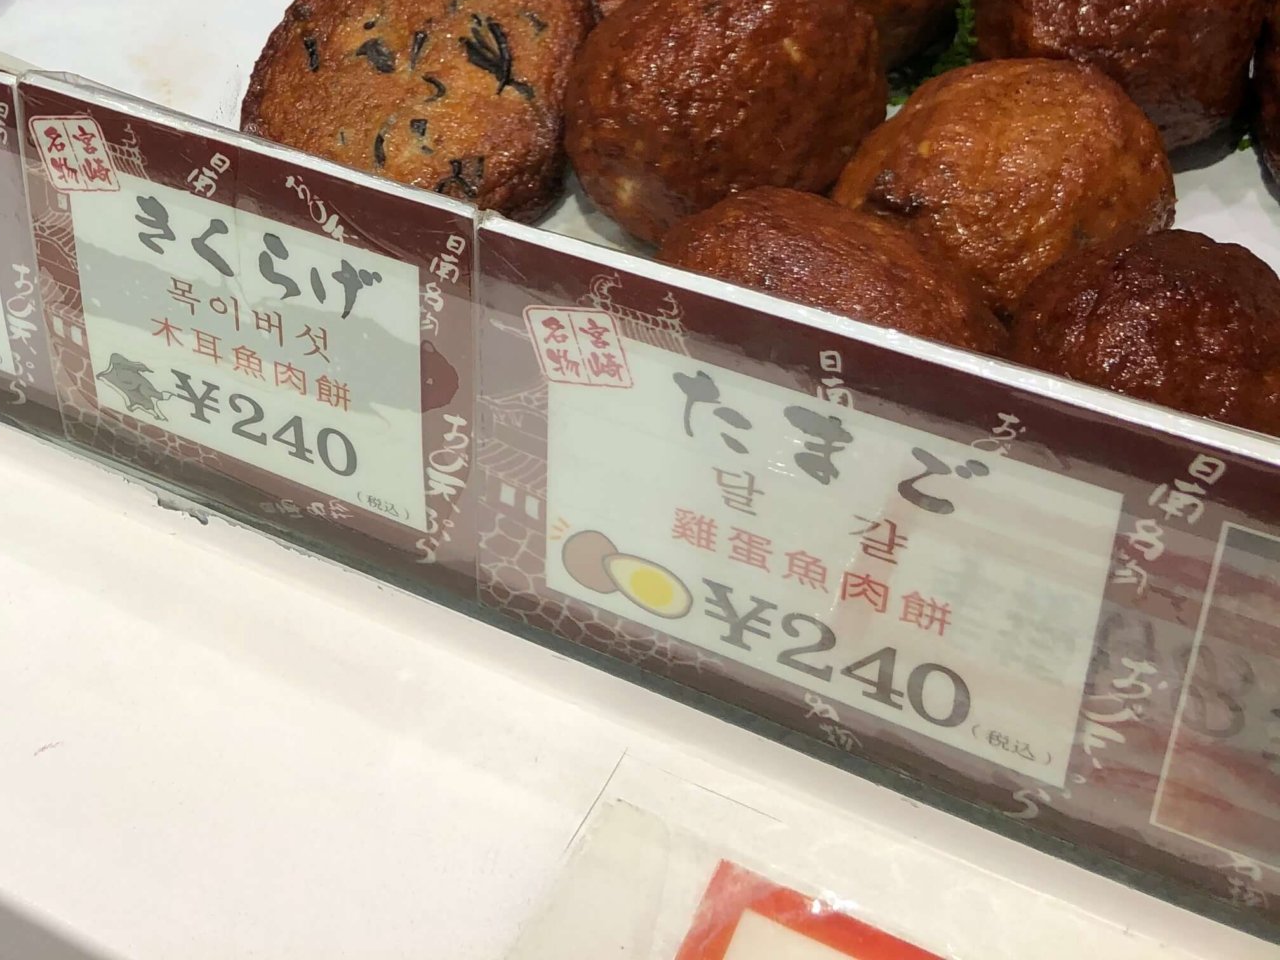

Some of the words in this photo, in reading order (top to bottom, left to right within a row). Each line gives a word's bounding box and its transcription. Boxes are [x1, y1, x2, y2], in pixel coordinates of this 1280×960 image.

[135, 195, 382, 319] きくらげ
[150, 317, 352, 413] 木耳魚肉餅
[166, 277, 331, 363] 목이버섯
[579, 318, 623, 381] 宮崎
[169, 368, 358, 477] ¥240
[673, 370, 989, 515] たまご
[672, 507, 952, 637] 雞蛋魚肉餅
[702, 577, 971, 728] ¥240
[971, 724, 1052, 765] (税込)
